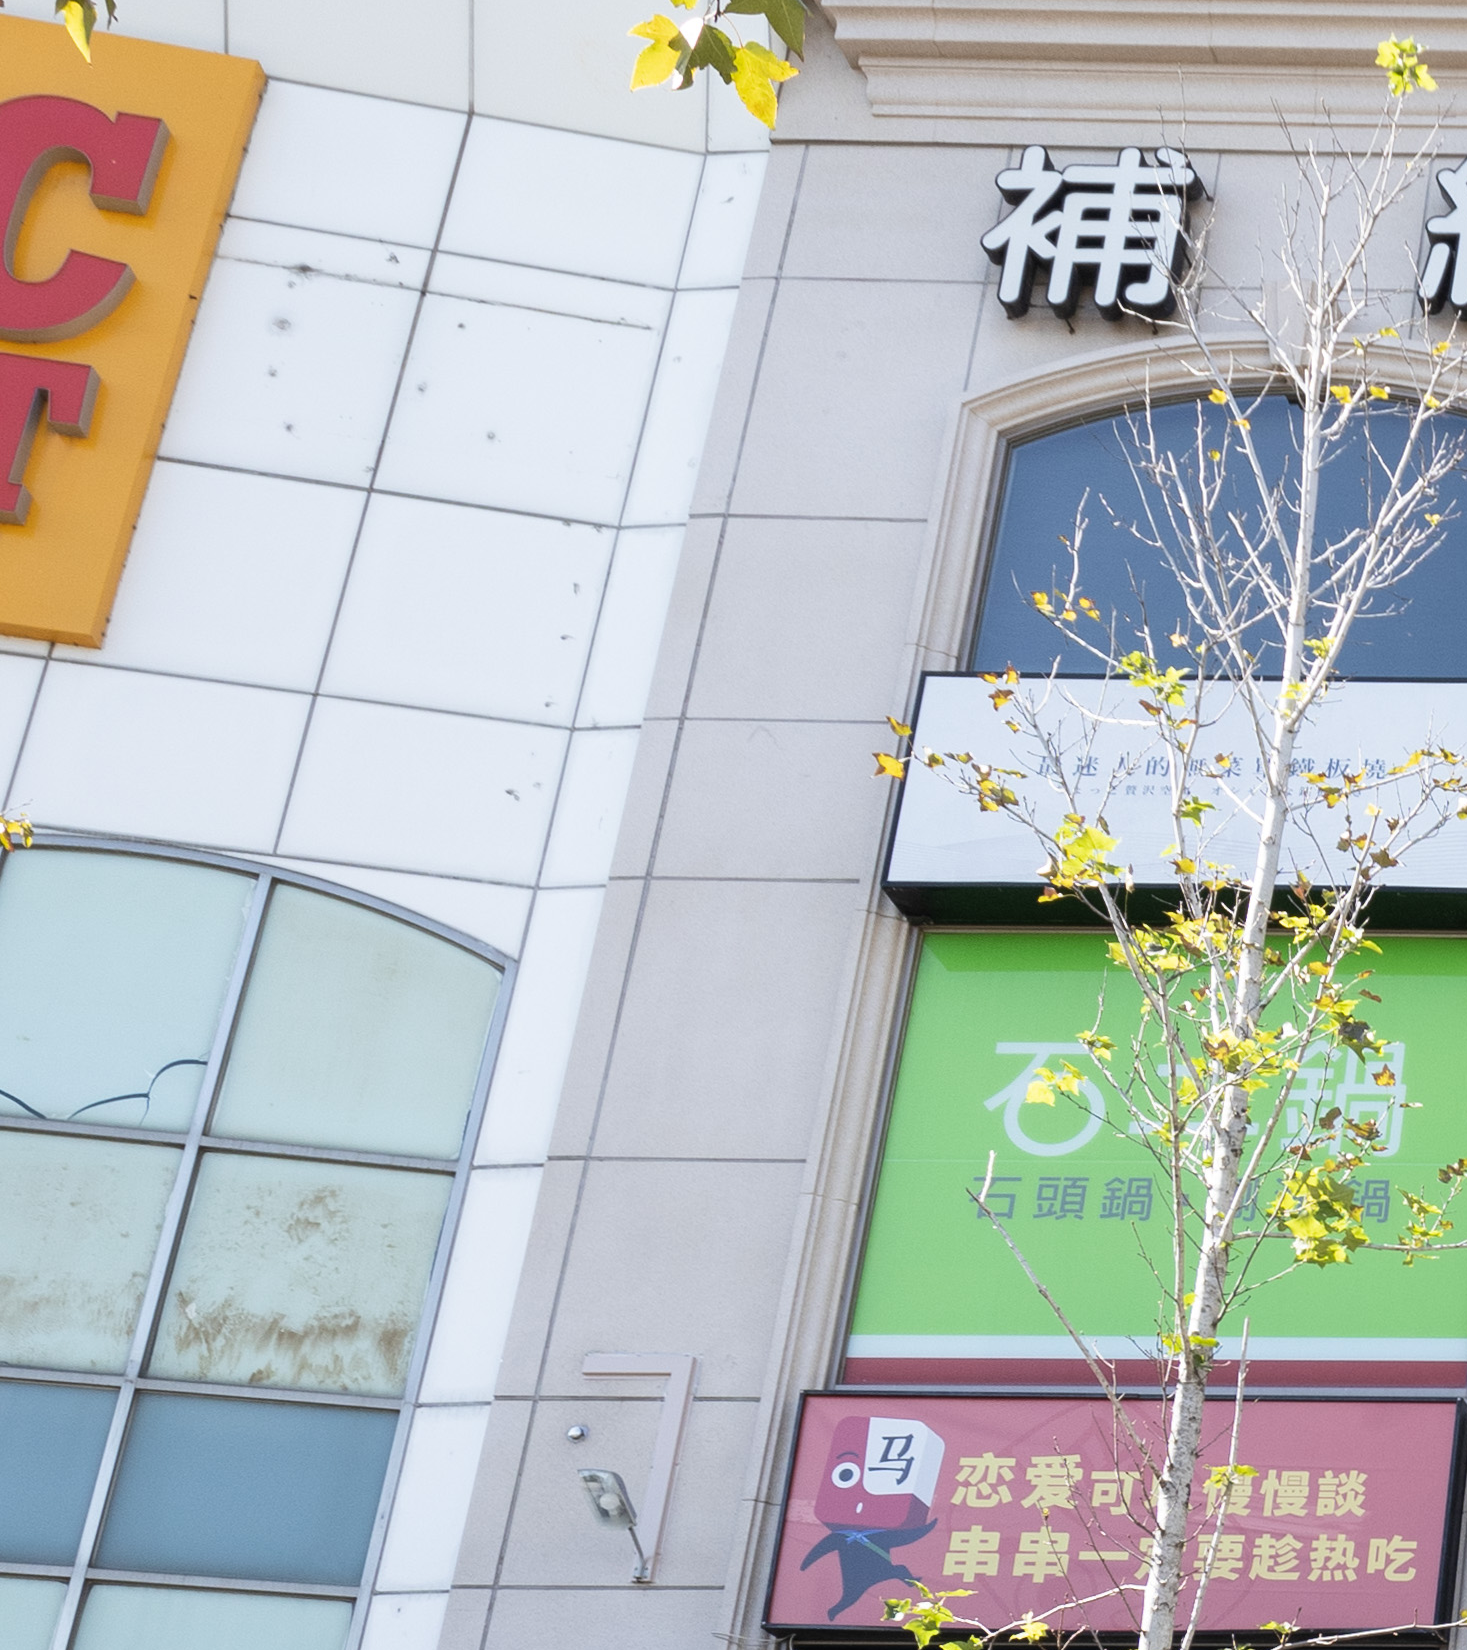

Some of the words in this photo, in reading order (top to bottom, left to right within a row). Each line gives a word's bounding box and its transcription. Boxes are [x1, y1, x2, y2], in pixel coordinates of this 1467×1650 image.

[867, 1433, 915, 1485] 马
[951, 1452, 1368, 1517] 恋爱可慢慢談
